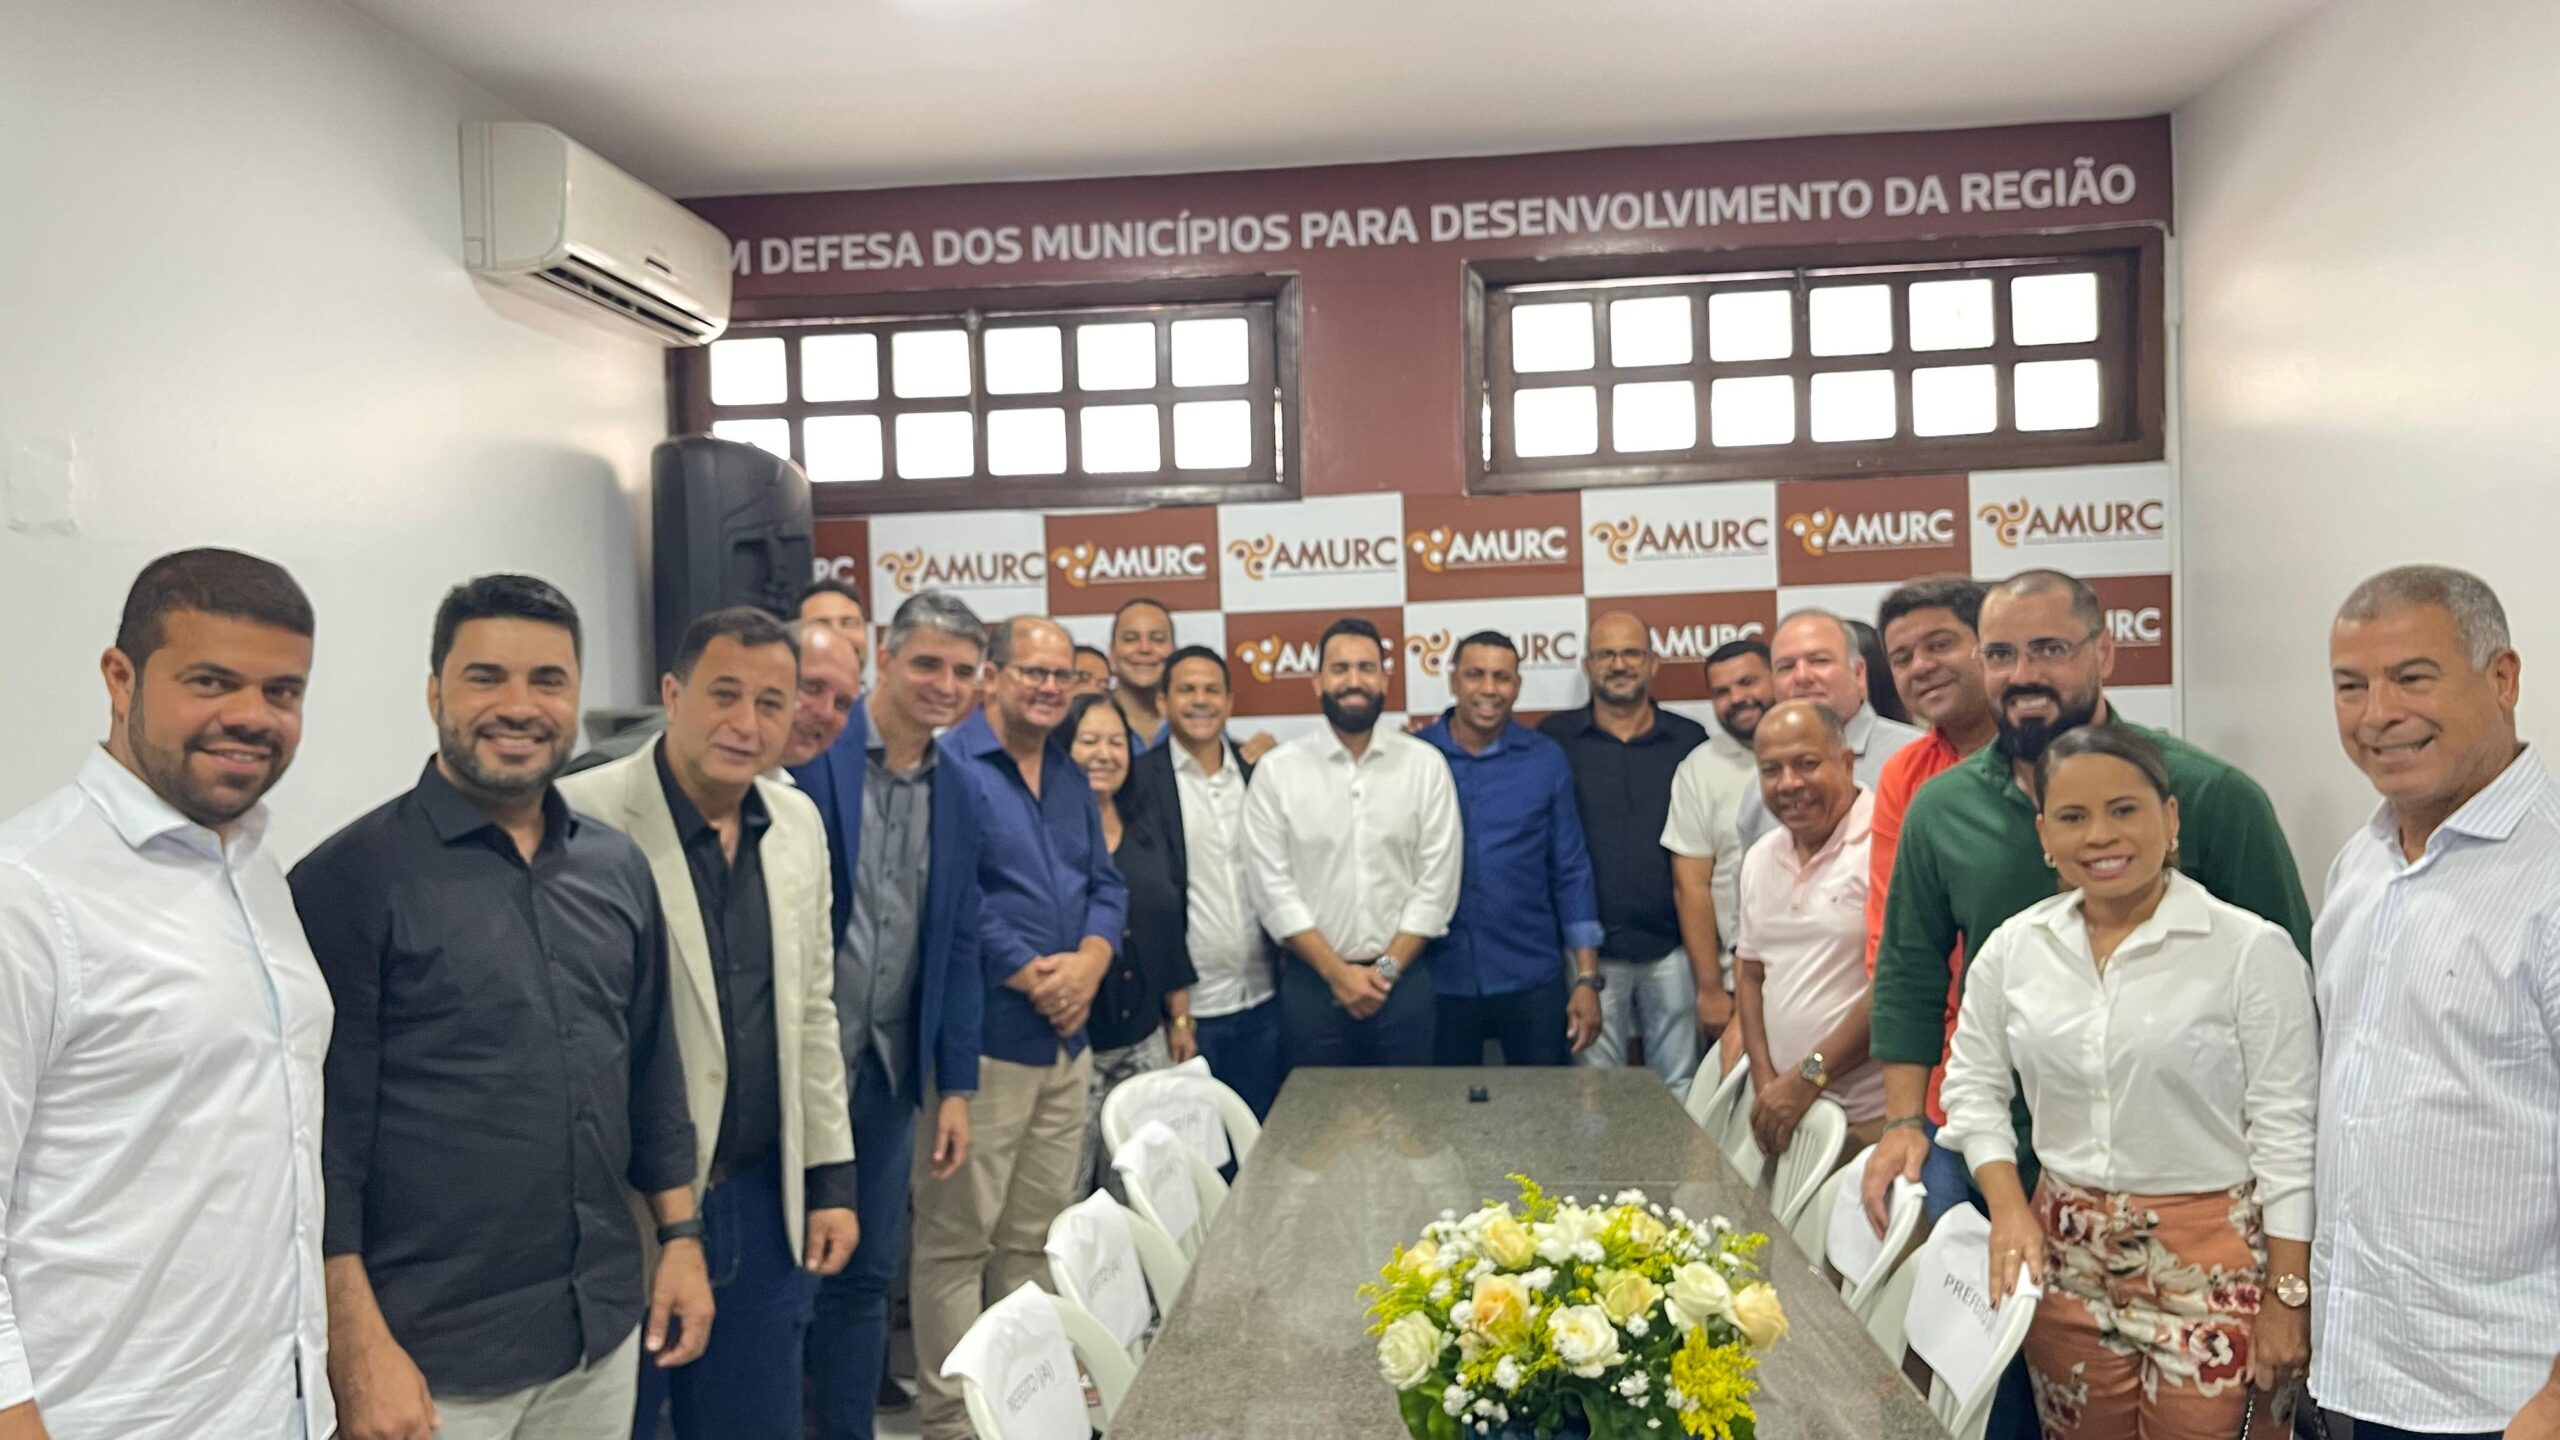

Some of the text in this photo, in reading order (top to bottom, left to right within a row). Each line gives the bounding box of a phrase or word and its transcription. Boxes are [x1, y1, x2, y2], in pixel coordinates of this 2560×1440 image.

[761, 231, 924, 274] DEFESA
[932, 226, 1023, 266] DOS
[1031, 209, 1292, 262] MUNICÍPIOS
[1301, 205, 1420, 249] PARA
[1430, 178, 1873, 242] DESENVOLVIMENTO
[1884, 175, 1950, 217] DA
[1960, 156, 2136, 213] REGIÃO
[1636, 517, 1768, 552] AMURC
[1828, 508, 1955, 545] AMURC
[2026, 501, 2164, 534] AMURC
[1090, 543, 1206, 578] AMURC
[1271, 536, 1397, 570] AMURC
[1446, 526, 1568, 564] AMURC
[922, 552, 1044, 583] AMURC
